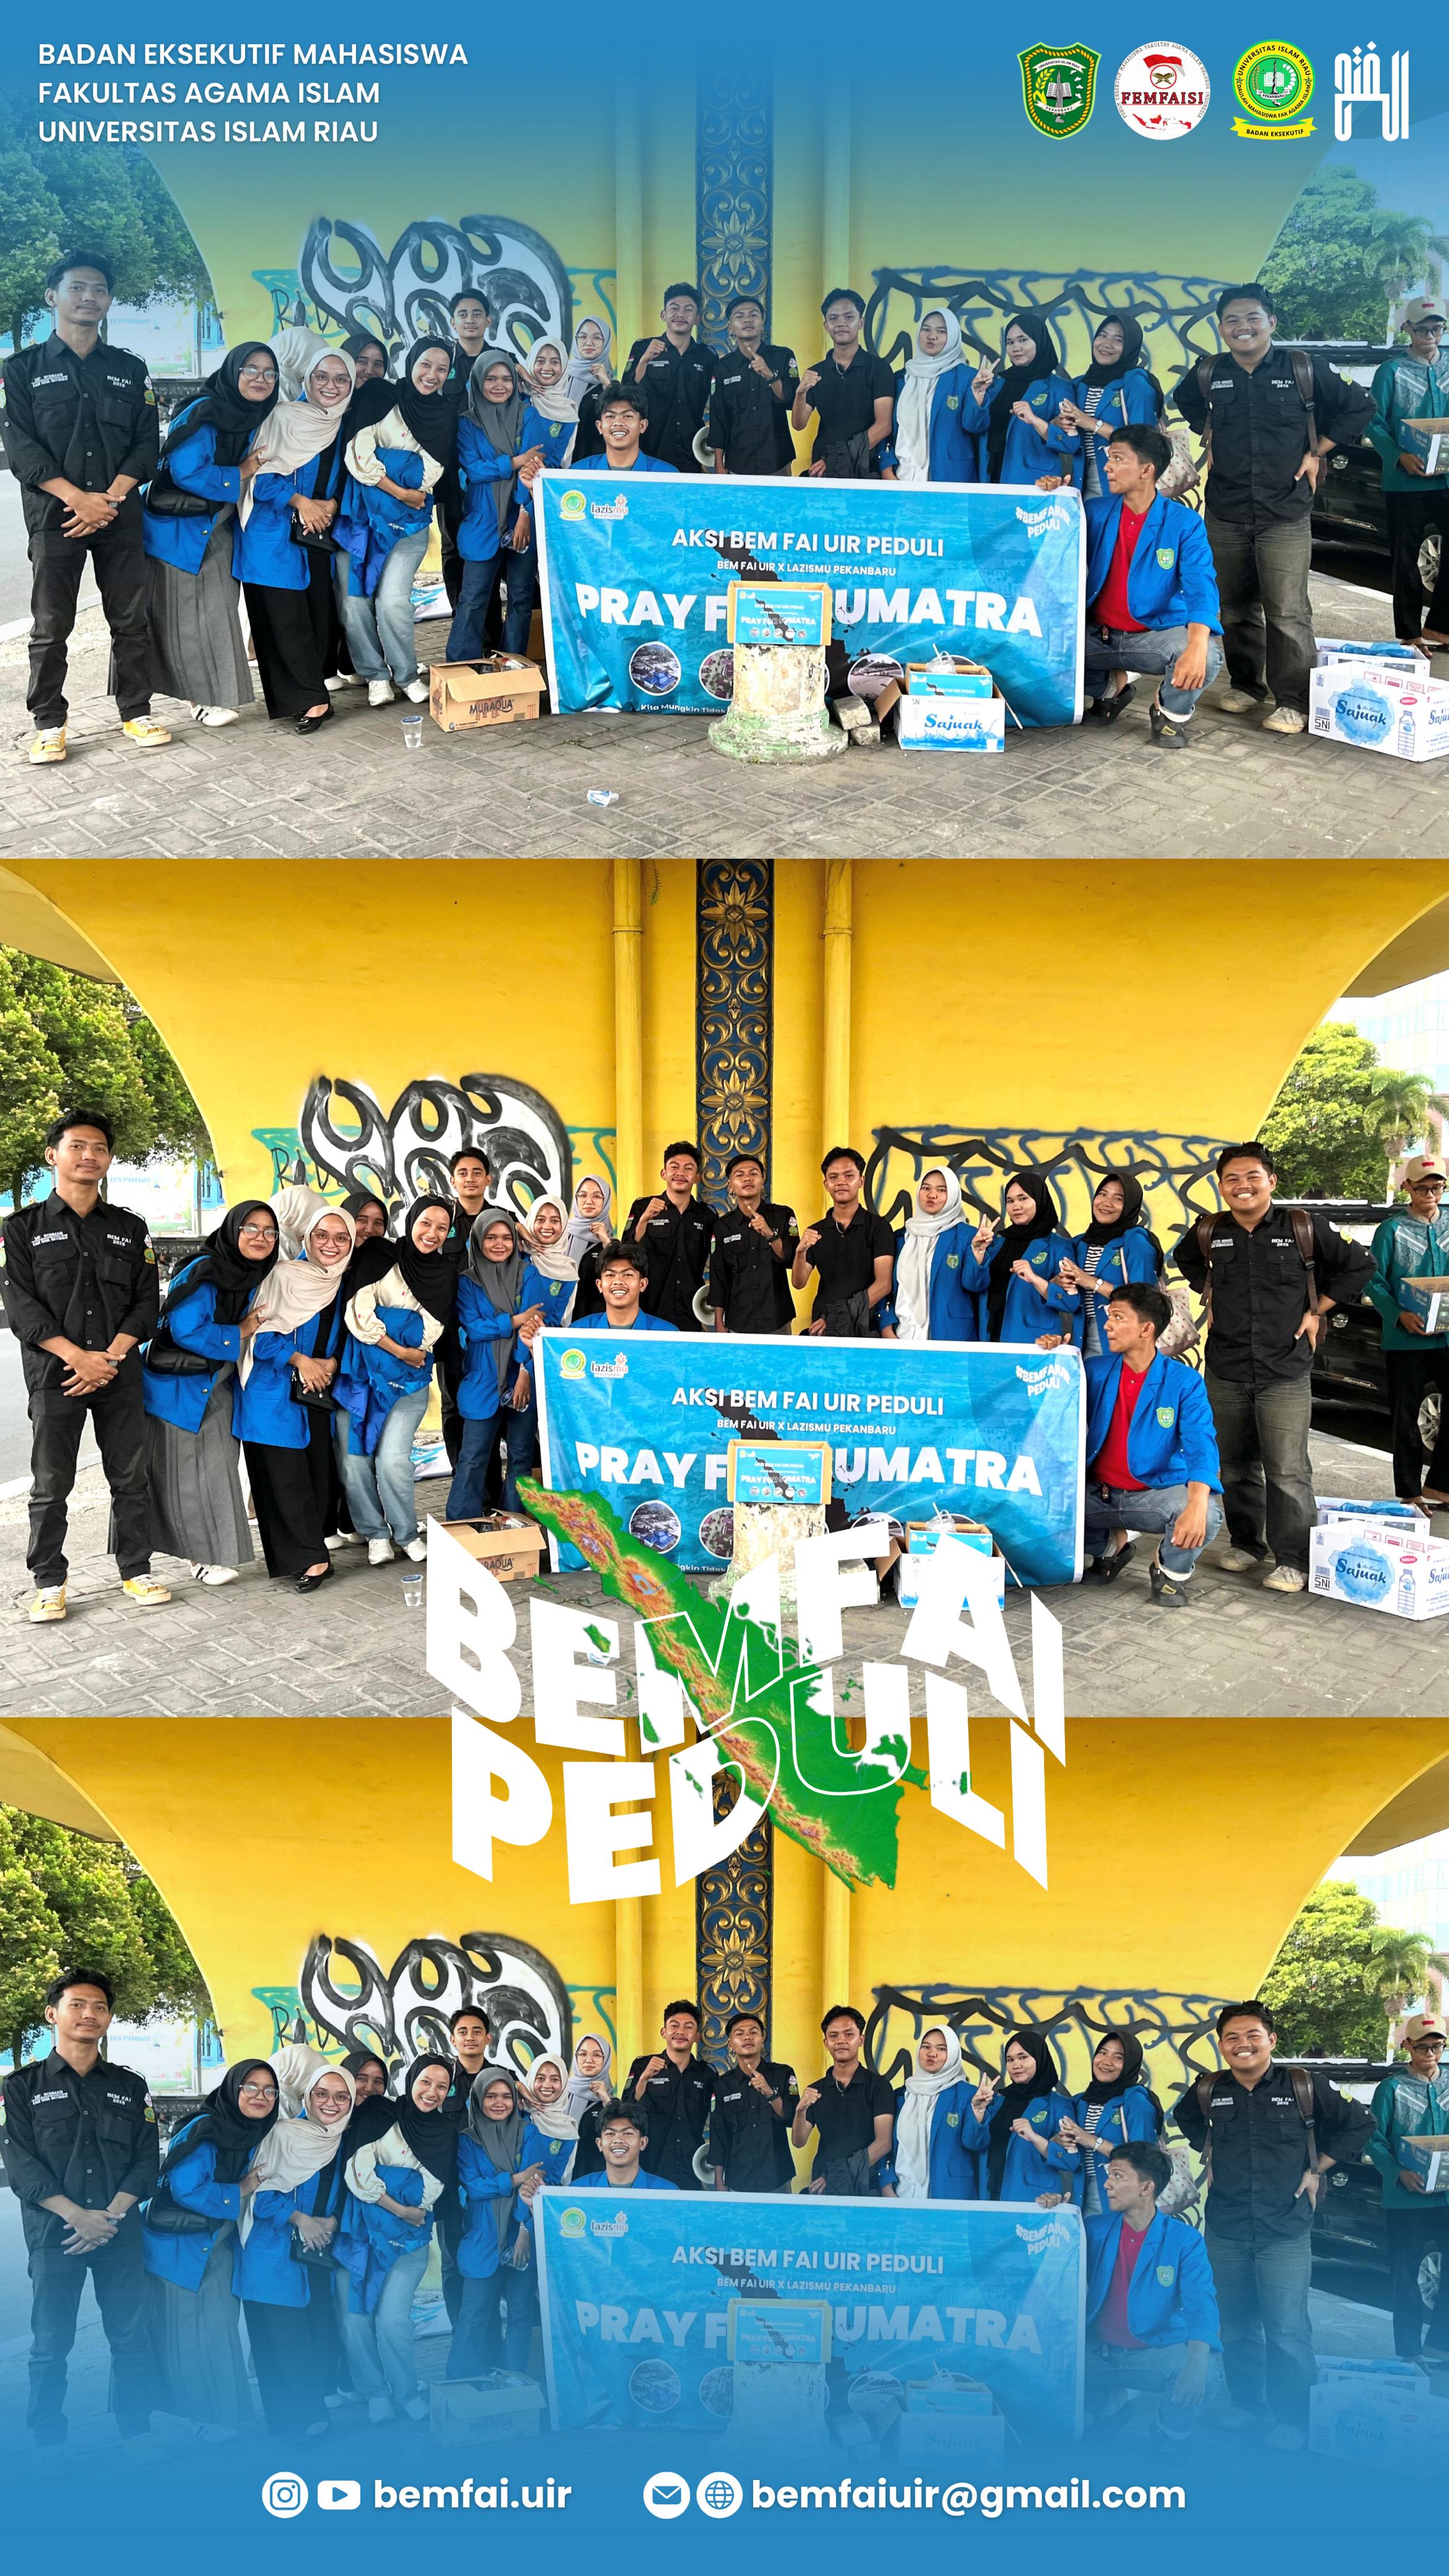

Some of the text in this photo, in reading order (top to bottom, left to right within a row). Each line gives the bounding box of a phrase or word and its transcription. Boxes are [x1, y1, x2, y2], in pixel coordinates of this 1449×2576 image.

[107, 375, 131, 386] BEM FAI
[591, 503, 628, 513] lazismu
[1027, 518, 1060, 538] PEDULI
[671, 529, 944, 557] AKSI BEM FAI UIR PEDULI
[716, 560, 896, 577] BEM FAI UIR X LAZISMU PEKANBARU
[575, 582, 698, 630] PRAY
[835, 588, 1043, 637] UMATRA
[741, 616, 762, 625] PRAY
[469, 698, 514, 715] MURAQUA
[661, 703, 700, 713] Mungkin
[1335, 699, 1387, 725] Sajuak
[924, 713, 983, 731] Sajuak
[1315, 718, 1330, 730] SNI
[107, 1234, 131, 1245] BEM FAI
[591, 1362, 628, 1372] lazismu
[1027, 1377, 1060, 1397] PEDULI
[671, 1388, 944, 1416] AKSI BEM FAI UIR PEDULI
[716, 1419, 896, 1435] BEM FAI UIR X LAZISMU PEKANBARU
[575, 1441, 698, 1489] PRAY
[835, 1447, 1043, 1496] UMATRA
[741, 1474, 762, 1484] PRAY
[483, 1557, 514, 1571] RAQUA
[1335, 1558, 1387, 1584] Sajuak
[1315, 1577, 1330, 1589] SNI
[107, 2092, 131, 2103] BEM FAI
[591, 2221, 628, 2230] lazismu
[1027, 2235, 1060, 2255] PEDULI
[671, 2247, 944, 2274] AKSI BEM FAI UIR PEDULI
[716, 2278, 896, 2294] BEM FAI UIR X LAZISMU PEKANBARU
[575, 2299, 698, 2347] PRAY
[835, 2305, 1043, 2354] UMATRA
